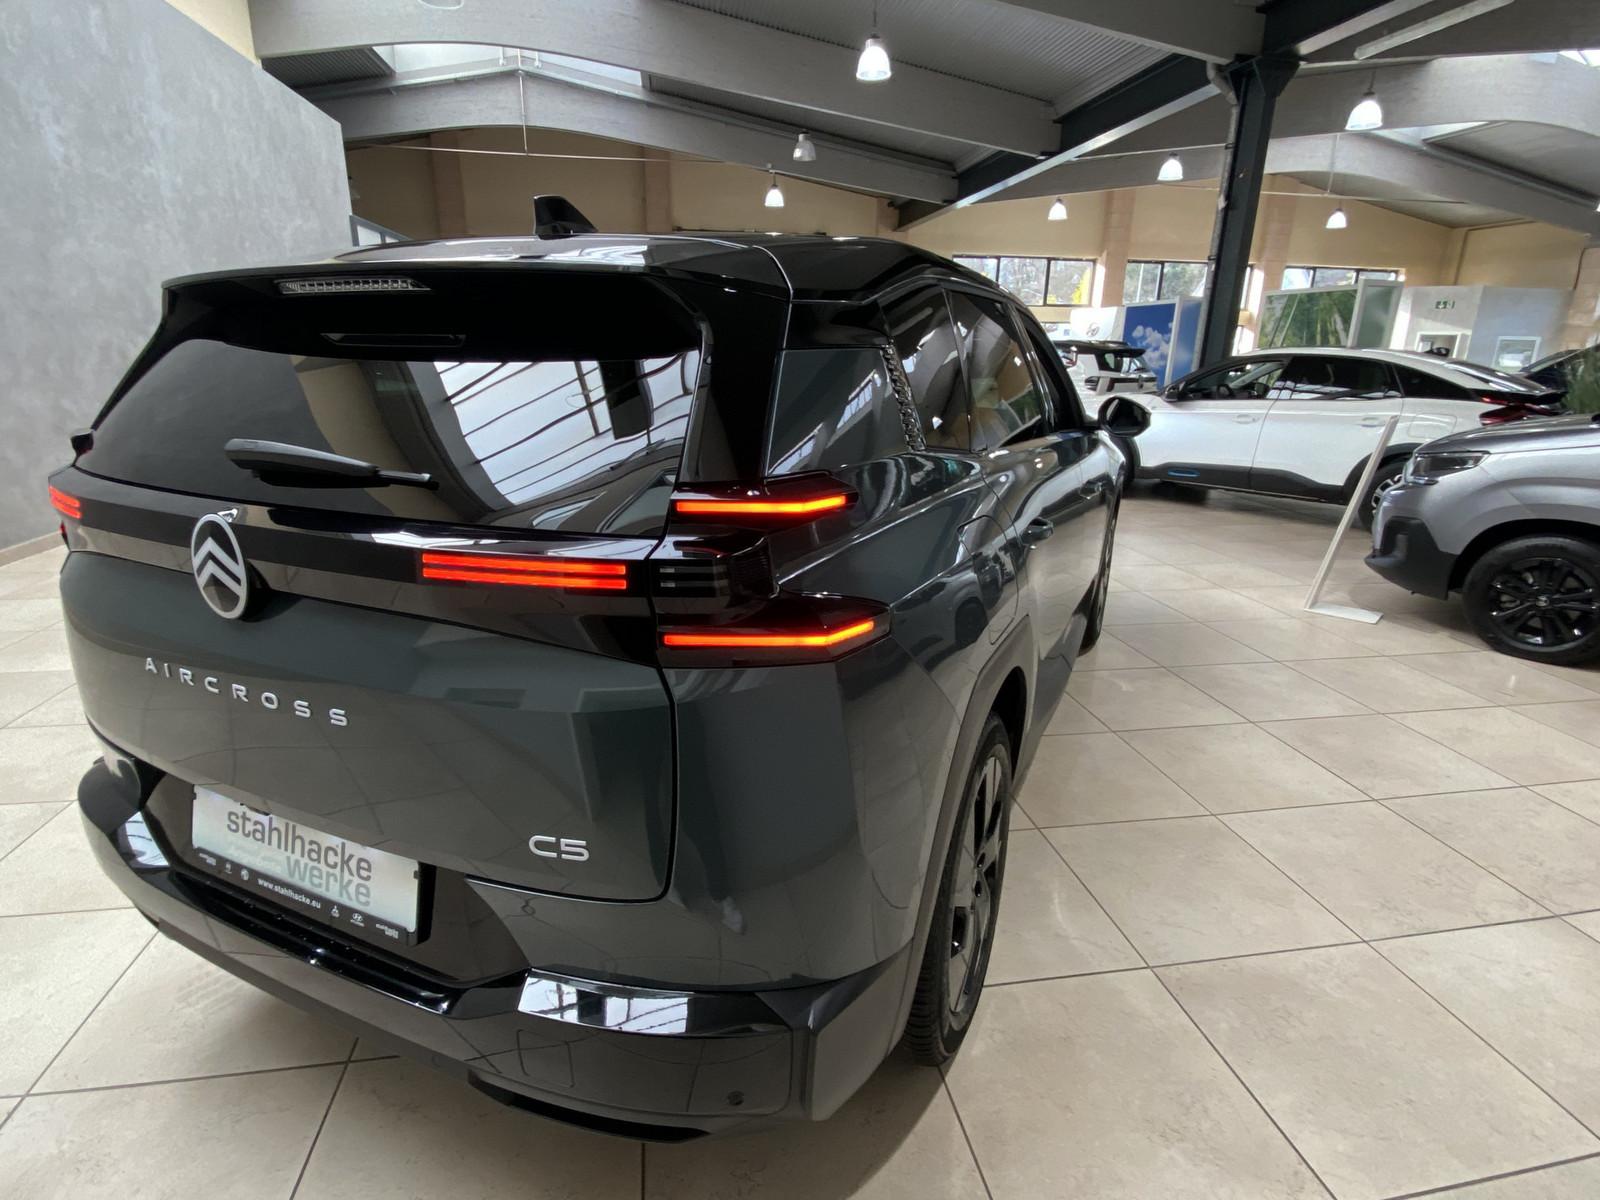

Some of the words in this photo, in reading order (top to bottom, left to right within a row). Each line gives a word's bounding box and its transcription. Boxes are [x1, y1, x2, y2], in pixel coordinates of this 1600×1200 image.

[145, 657, 348, 726] AIRCROSS
[227, 810, 372, 882] stahlhacke
[529, 835, 589, 861] C5
[286, 856, 371, 907] werke
